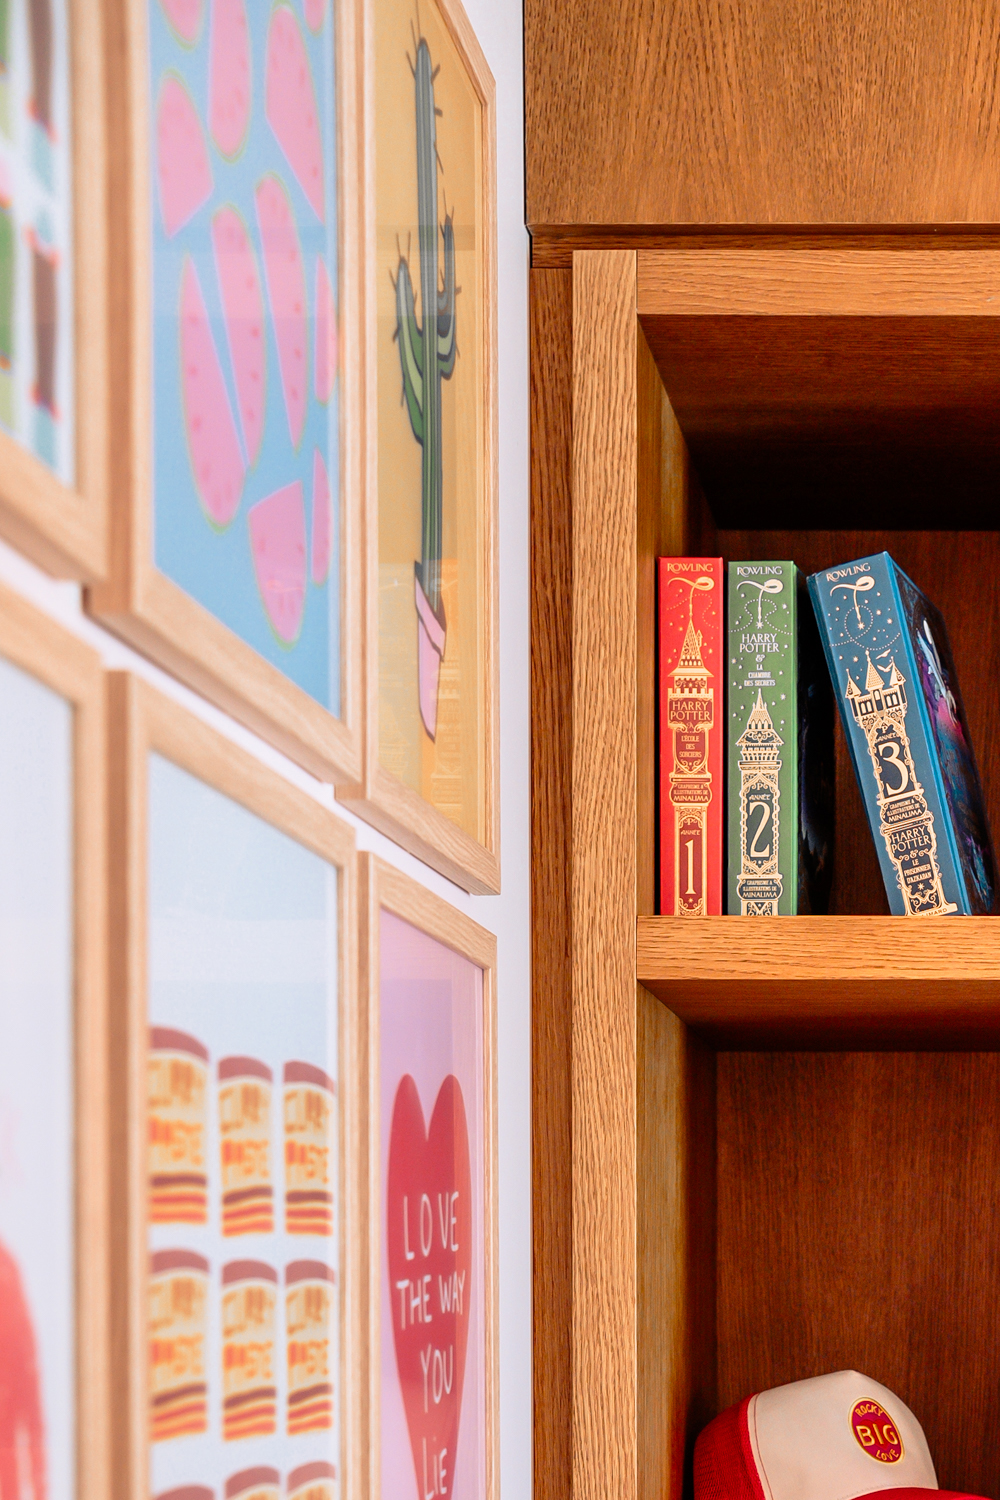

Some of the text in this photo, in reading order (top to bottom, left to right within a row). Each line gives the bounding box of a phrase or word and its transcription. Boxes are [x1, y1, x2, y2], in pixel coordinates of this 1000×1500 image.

[667, 563, 714, 574] ROWLING
[737, 566, 783, 577] ROWLING
[826, 562, 871, 582] ROWLING
[741, 633, 777, 643] HARRY
[739, 643, 780, 653] POTTER
[755, 654, 765, 662] &
[672, 701, 709, 711] HARRY
[670, 711, 711, 721] POTTER
[878, 741, 909, 797] 3
[888, 808, 922, 823] MINALIMA
[749, 801, 771, 858] 2
[891, 825, 925, 844] HARRY
[891, 834, 932, 854] POTTER
[684, 839, 697, 895] 1
[911, 858, 920, 867] LE
[403, 1190, 459, 1261] LOVE
[396, 1269, 466, 1330] THE WAY
[420, 1342, 454, 1414] YOU
[855, 1403, 884, 1417] ROCKY
[856, 1423, 899, 1447] BIG
[876, 1448, 899, 1461] LOVE
